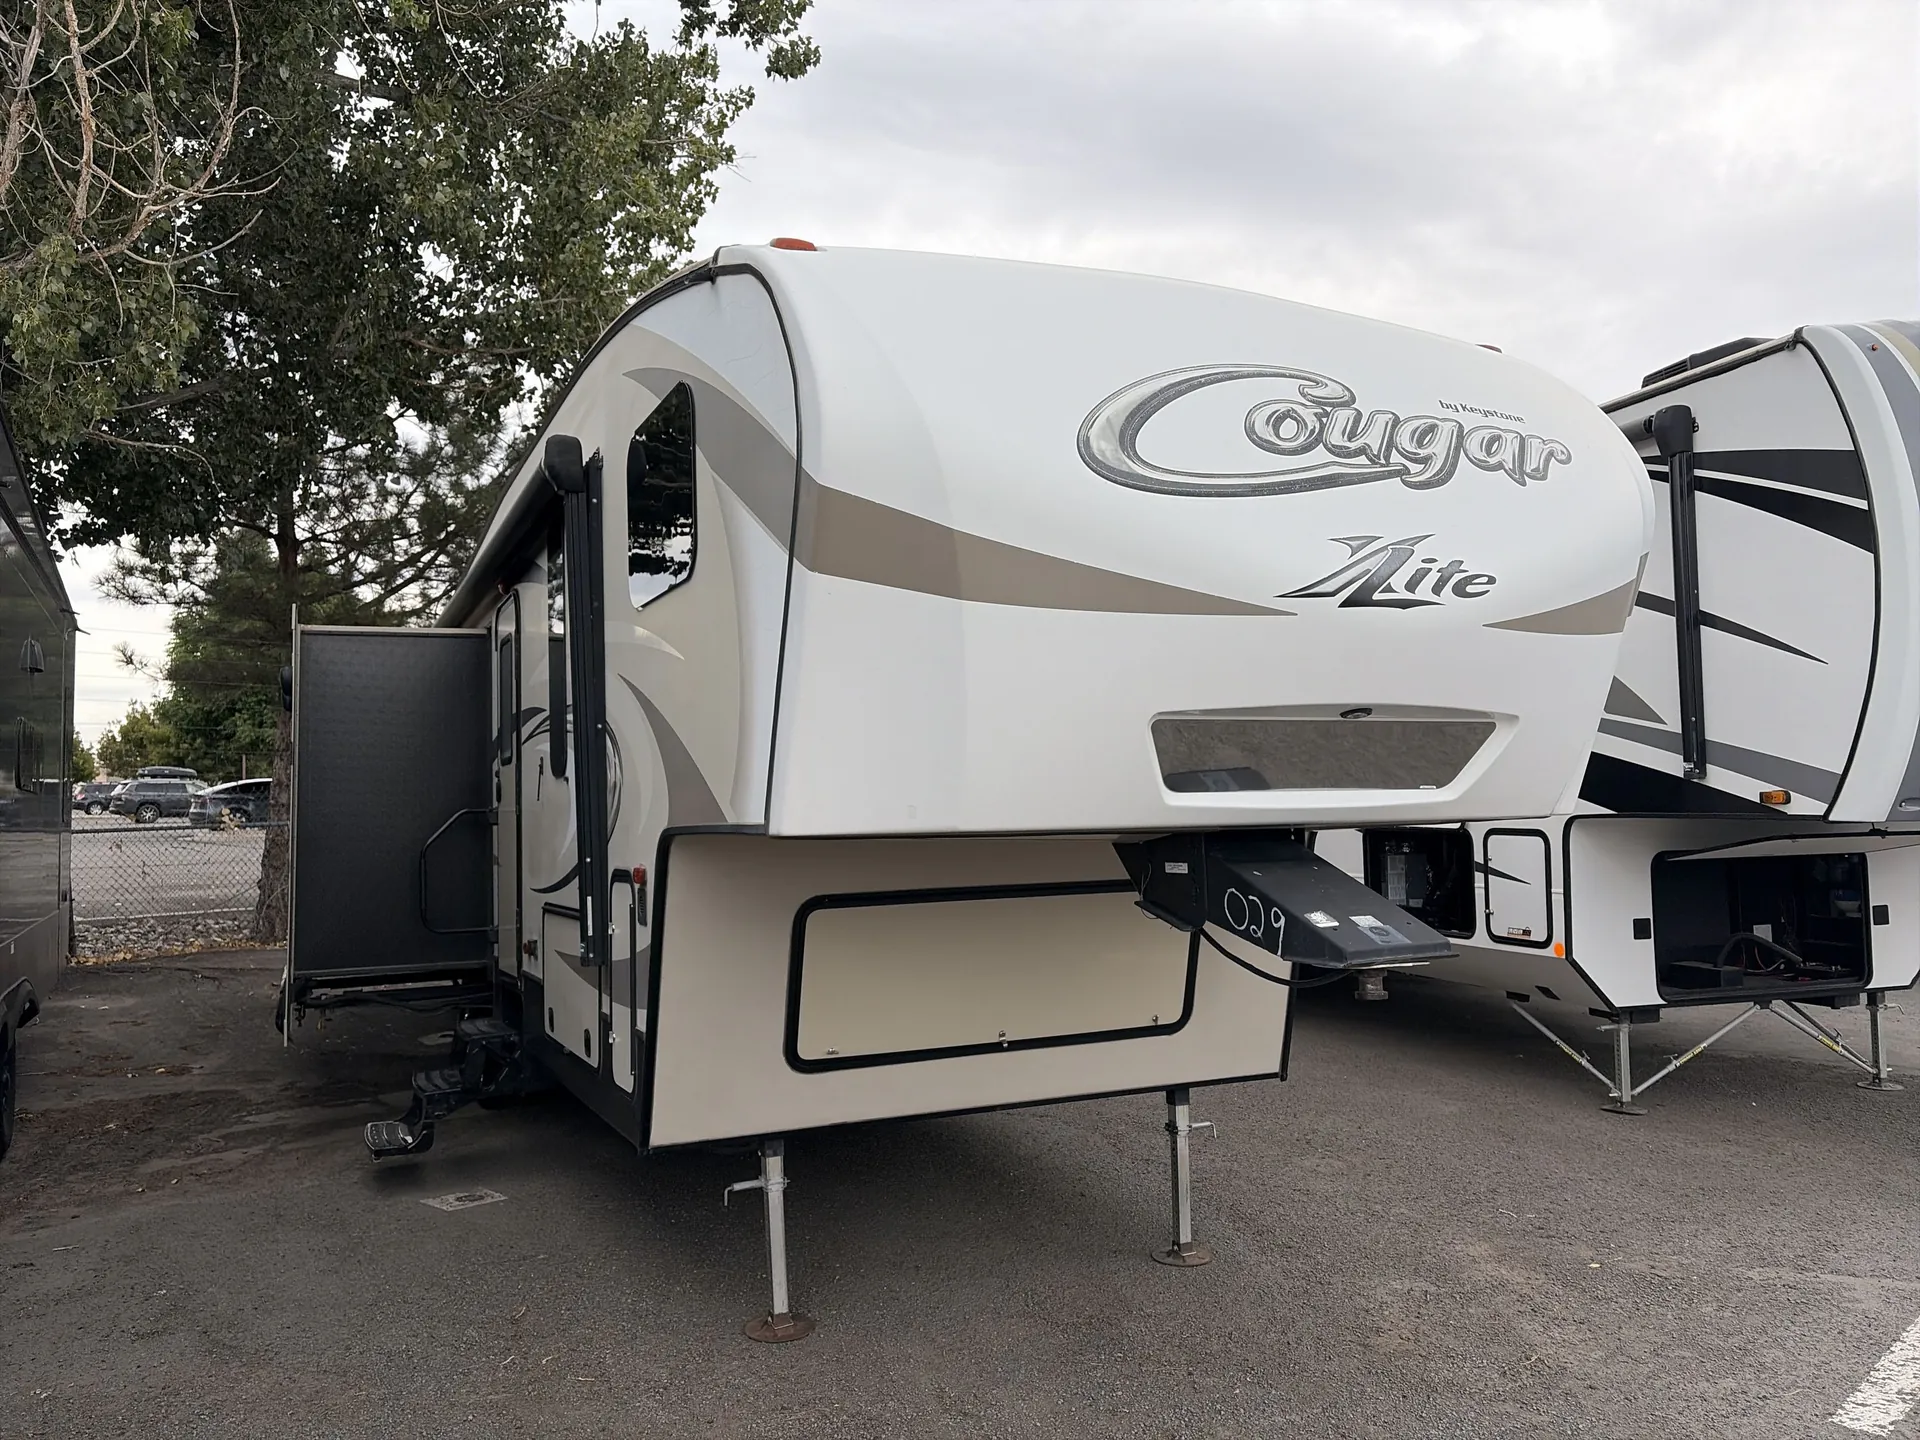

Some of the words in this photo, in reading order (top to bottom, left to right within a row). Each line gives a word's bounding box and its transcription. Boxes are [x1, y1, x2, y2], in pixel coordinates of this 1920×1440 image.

[1077, 364, 1572, 497] Cougar
[1438, 399, 1460, 413] by
[1459, 402, 1526, 424] Keystone
[1224, 887, 1286, 956] 029
